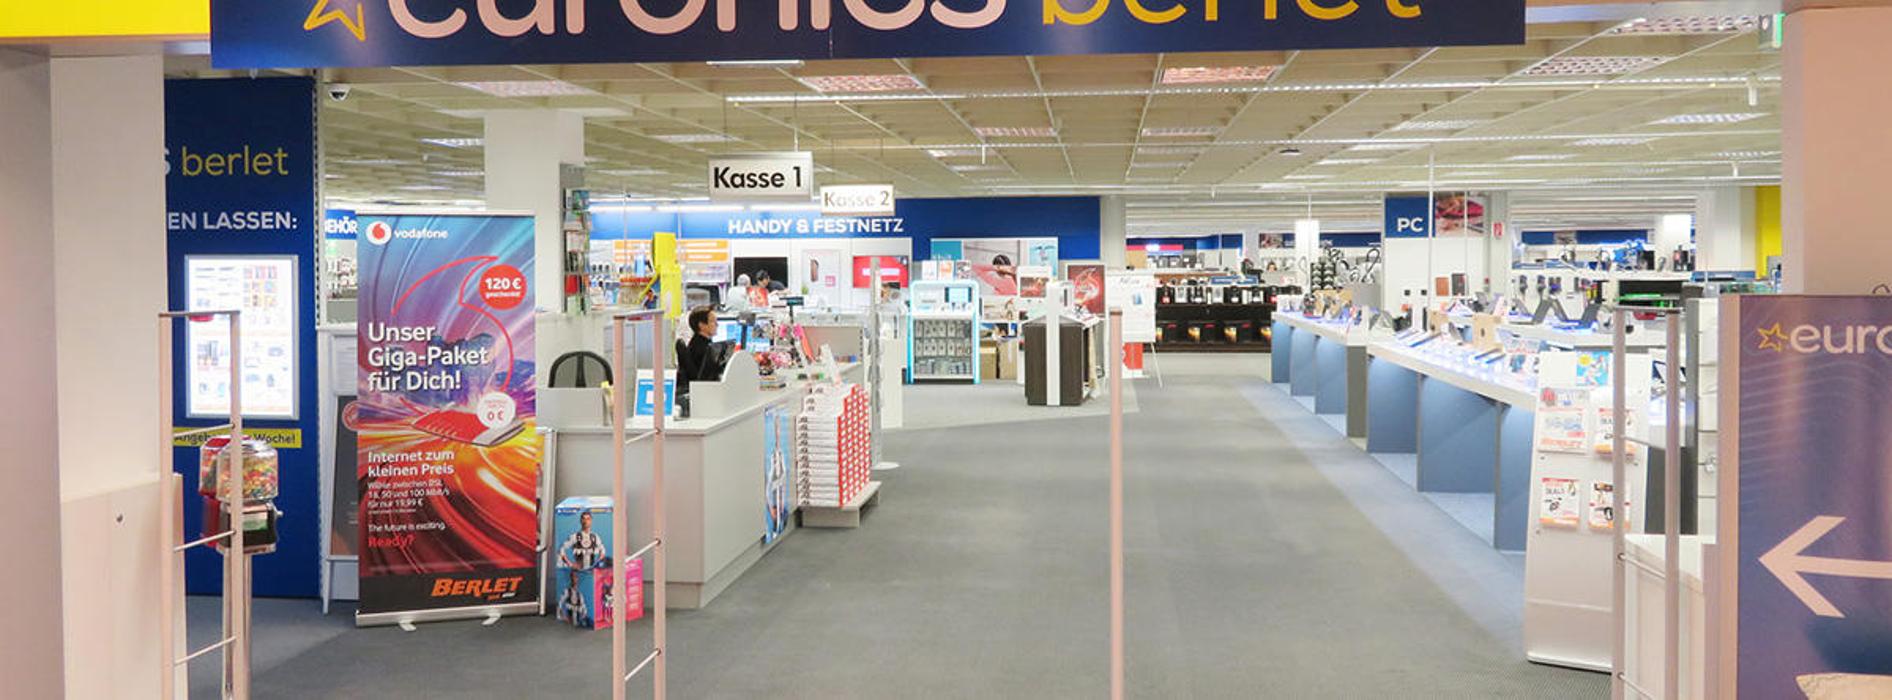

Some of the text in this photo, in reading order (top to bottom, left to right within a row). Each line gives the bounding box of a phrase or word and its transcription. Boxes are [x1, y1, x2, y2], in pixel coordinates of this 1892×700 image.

[182, 145, 289, 176] berlet
[713, 166, 801, 188] Kasse 1
[824, 190, 890, 208] Kasse 2
[203, 211, 298, 230] LASSEN:
[325, 216, 357, 234] EHÖR
[728, 217, 905, 235] HANDY & FESTNETZ
[1397, 217, 1423, 232] PC
[394, 228, 449, 239] vodafone
[486, 277, 522, 290] 120 €
[368, 322, 435, 342] Unser
[368, 345, 490, 371] Giga-Paket
[368, 370, 461, 392] für Dich!
[368, 450, 455, 463] Internet zum
[368, 463, 455, 477] kleinen Preis
[368, 534, 415, 546] Ready?
[431, 577, 523, 597] BERLET
